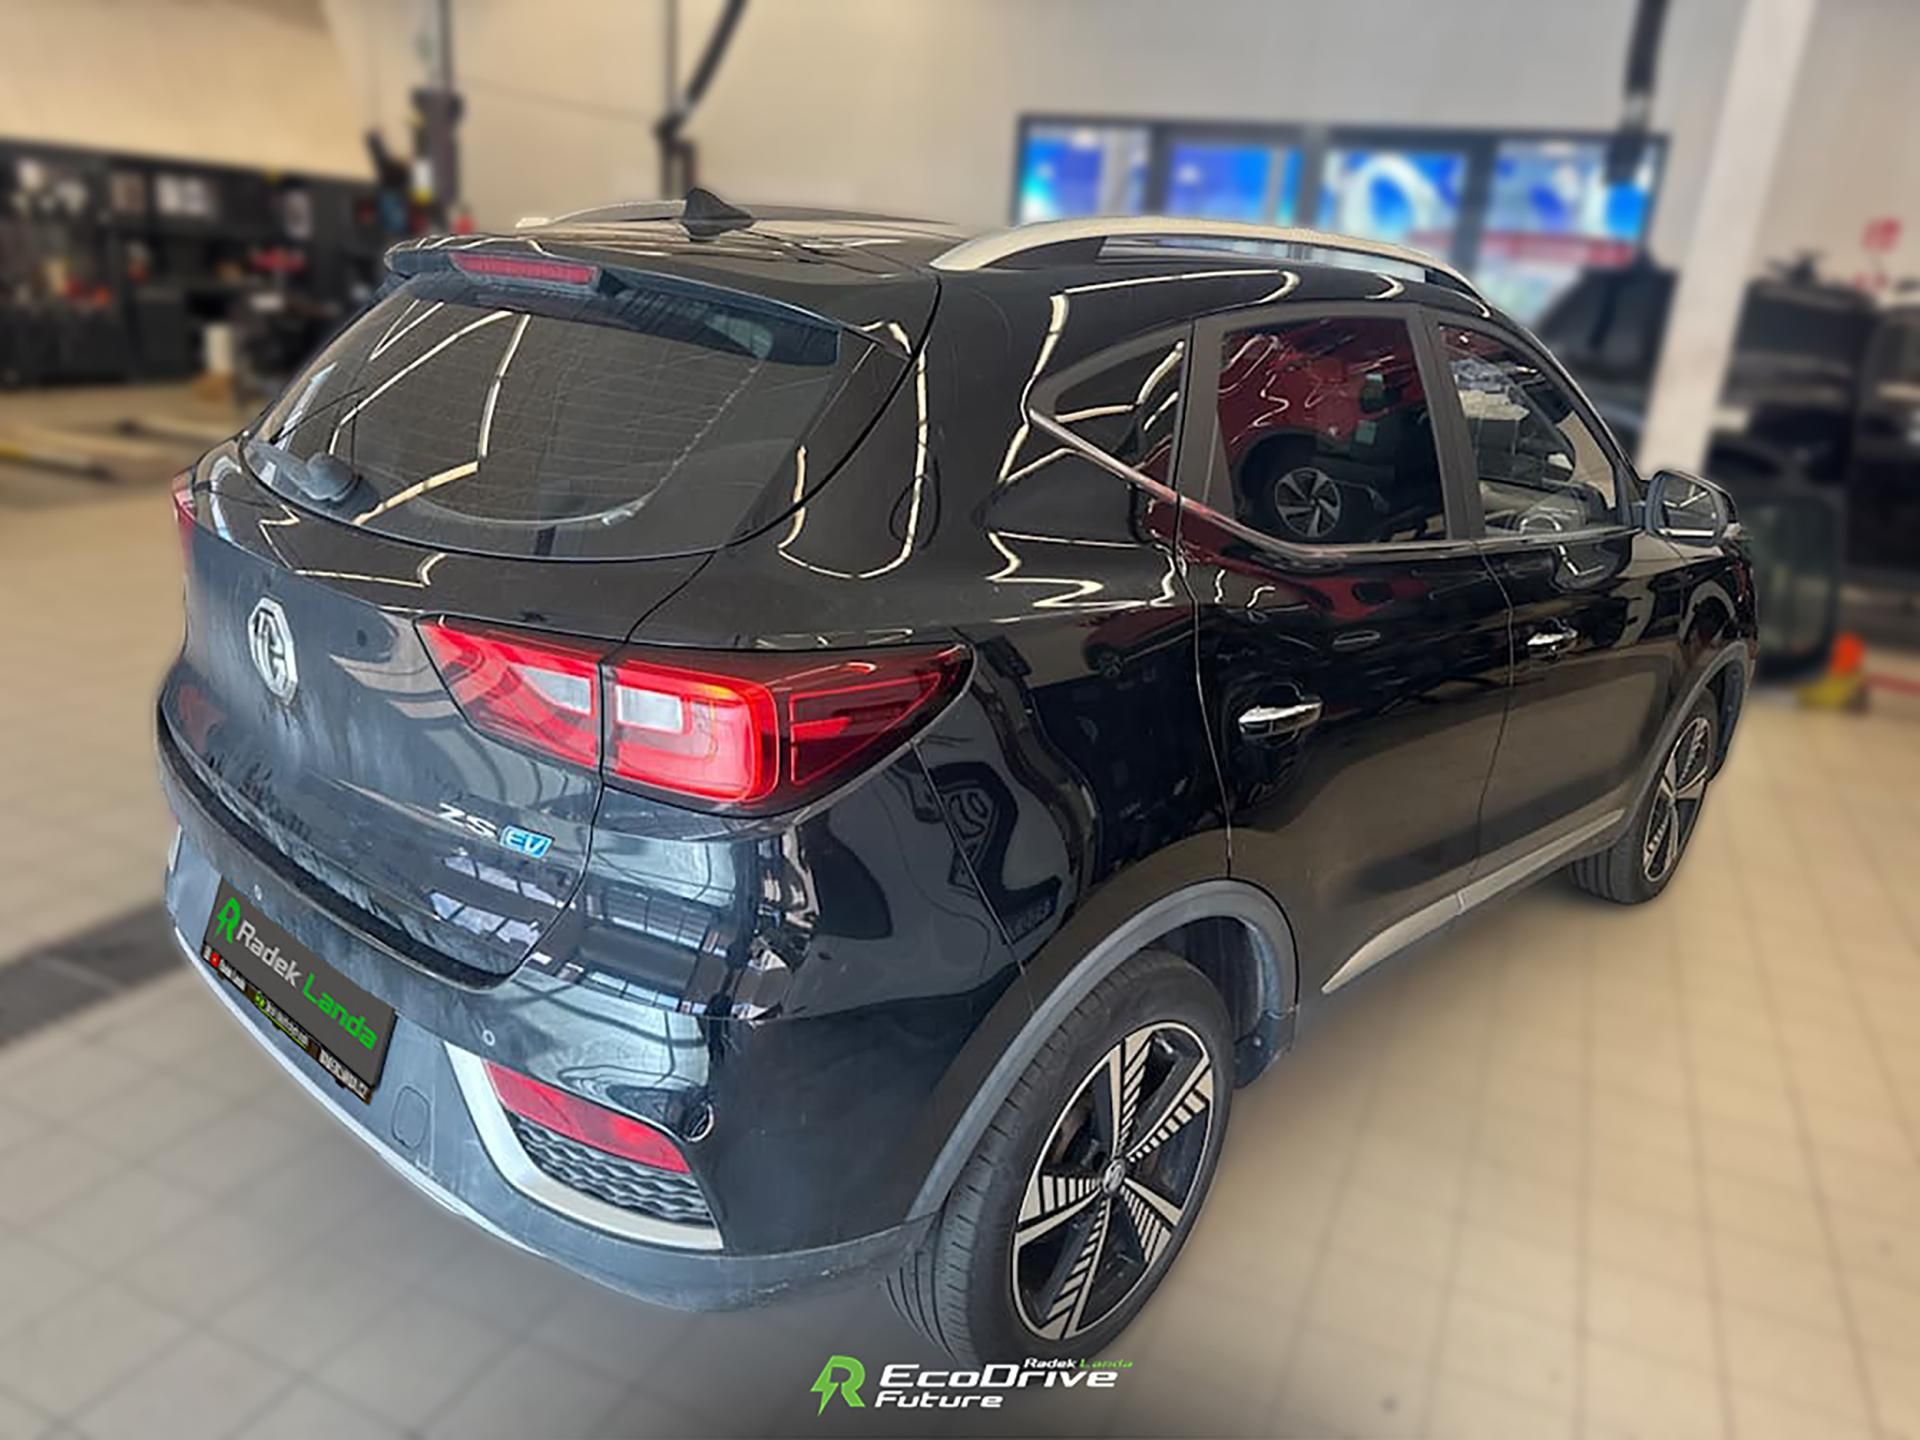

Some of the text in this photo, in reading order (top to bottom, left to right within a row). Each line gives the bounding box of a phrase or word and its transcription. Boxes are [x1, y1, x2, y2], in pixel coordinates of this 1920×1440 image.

[251, 602, 294, 699] MG
[437, 802, 547, 855] ZS EV
